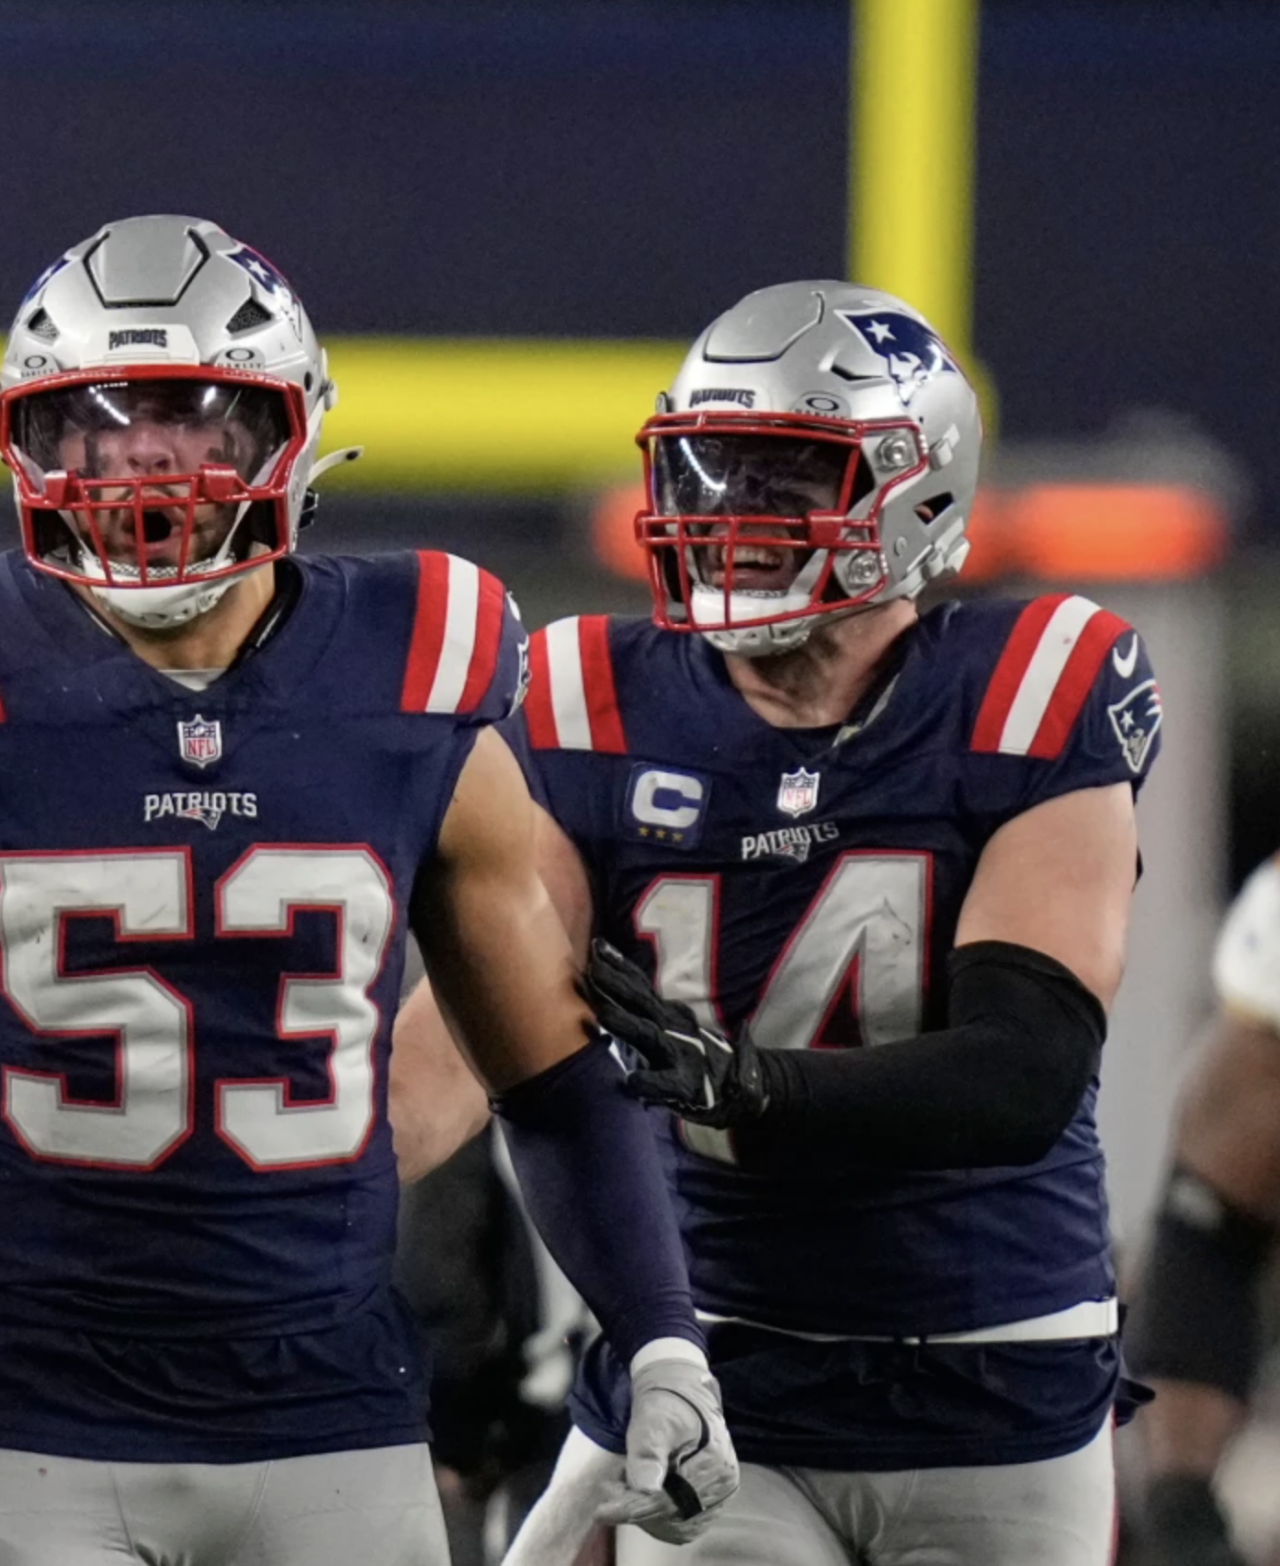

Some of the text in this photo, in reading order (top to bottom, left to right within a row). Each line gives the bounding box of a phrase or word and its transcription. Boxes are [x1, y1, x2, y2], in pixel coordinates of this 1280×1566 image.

[187, 739, 217, 758] NFL
[144, 791, 258, 822] PATRIOTS
[632, 770, 703, 829] C
[741, 821, 840, 860] PATRIOTS
[633, 849, 933, 1165] 14
